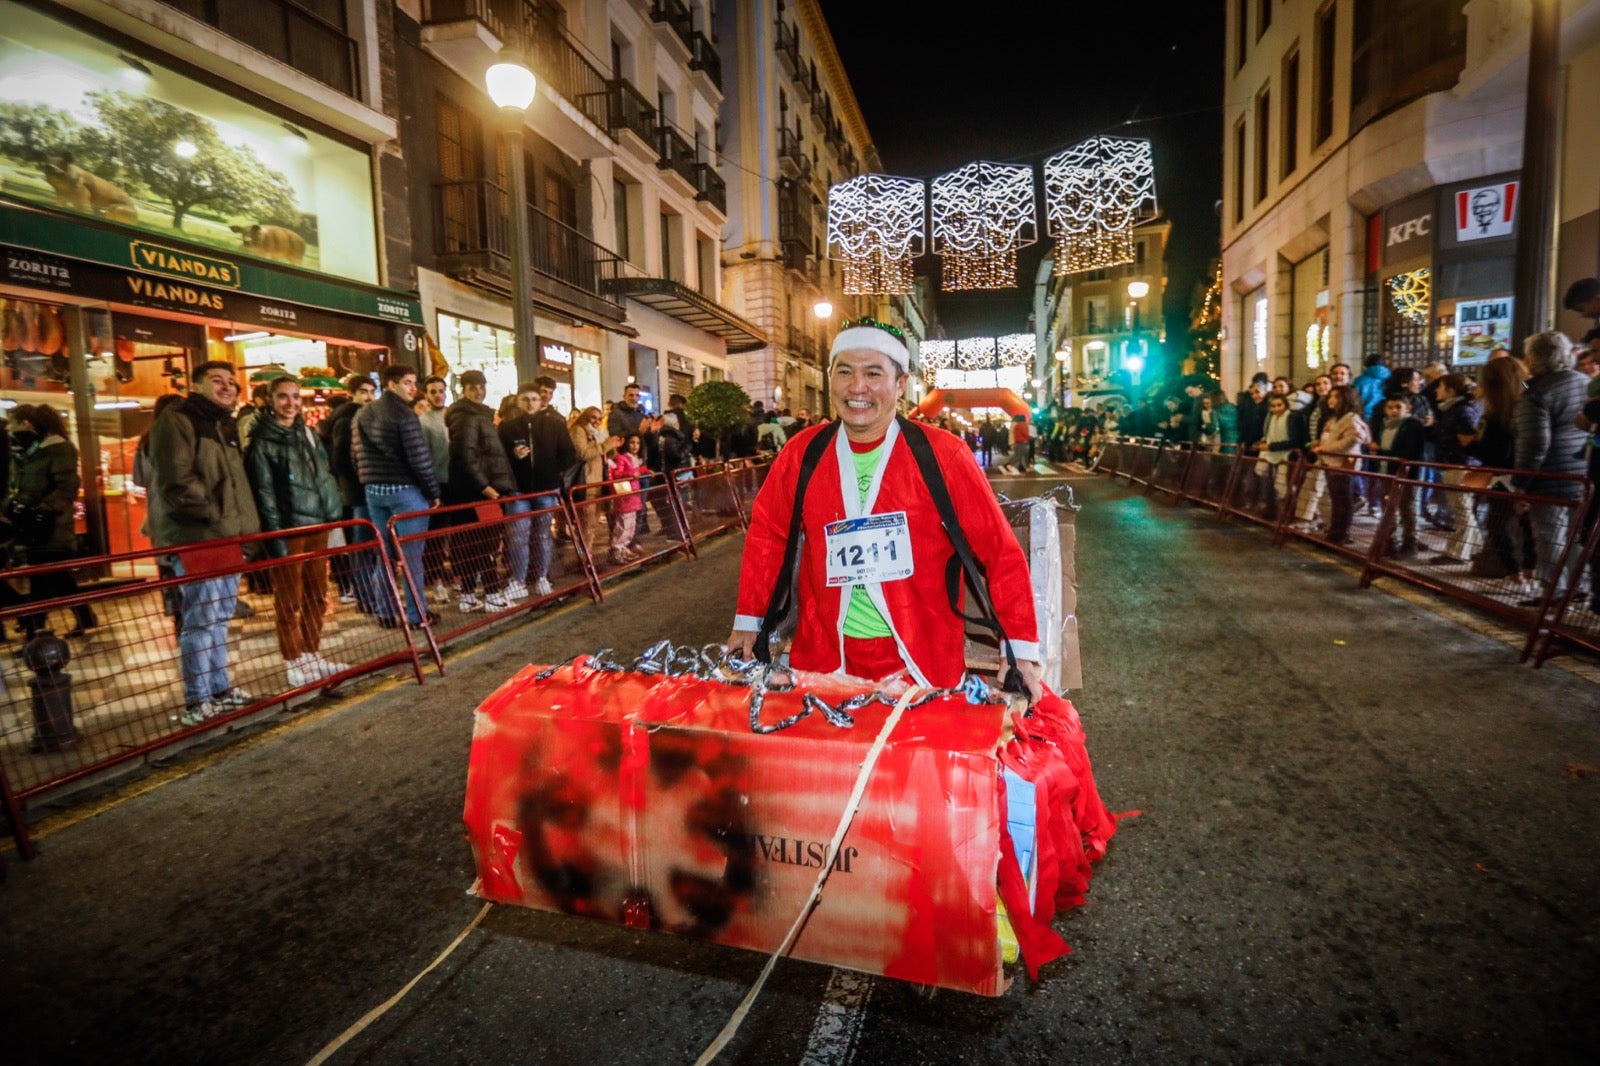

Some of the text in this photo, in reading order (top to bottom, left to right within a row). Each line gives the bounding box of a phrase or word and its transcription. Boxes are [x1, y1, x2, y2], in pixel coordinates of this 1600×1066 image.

[1386, 214, 1432, 247] KFC
[141, 248, 231, 281] VIANDAS
[127, 276, 224, 310] VIANDAS
[836, 540, 897, 567] 1211
